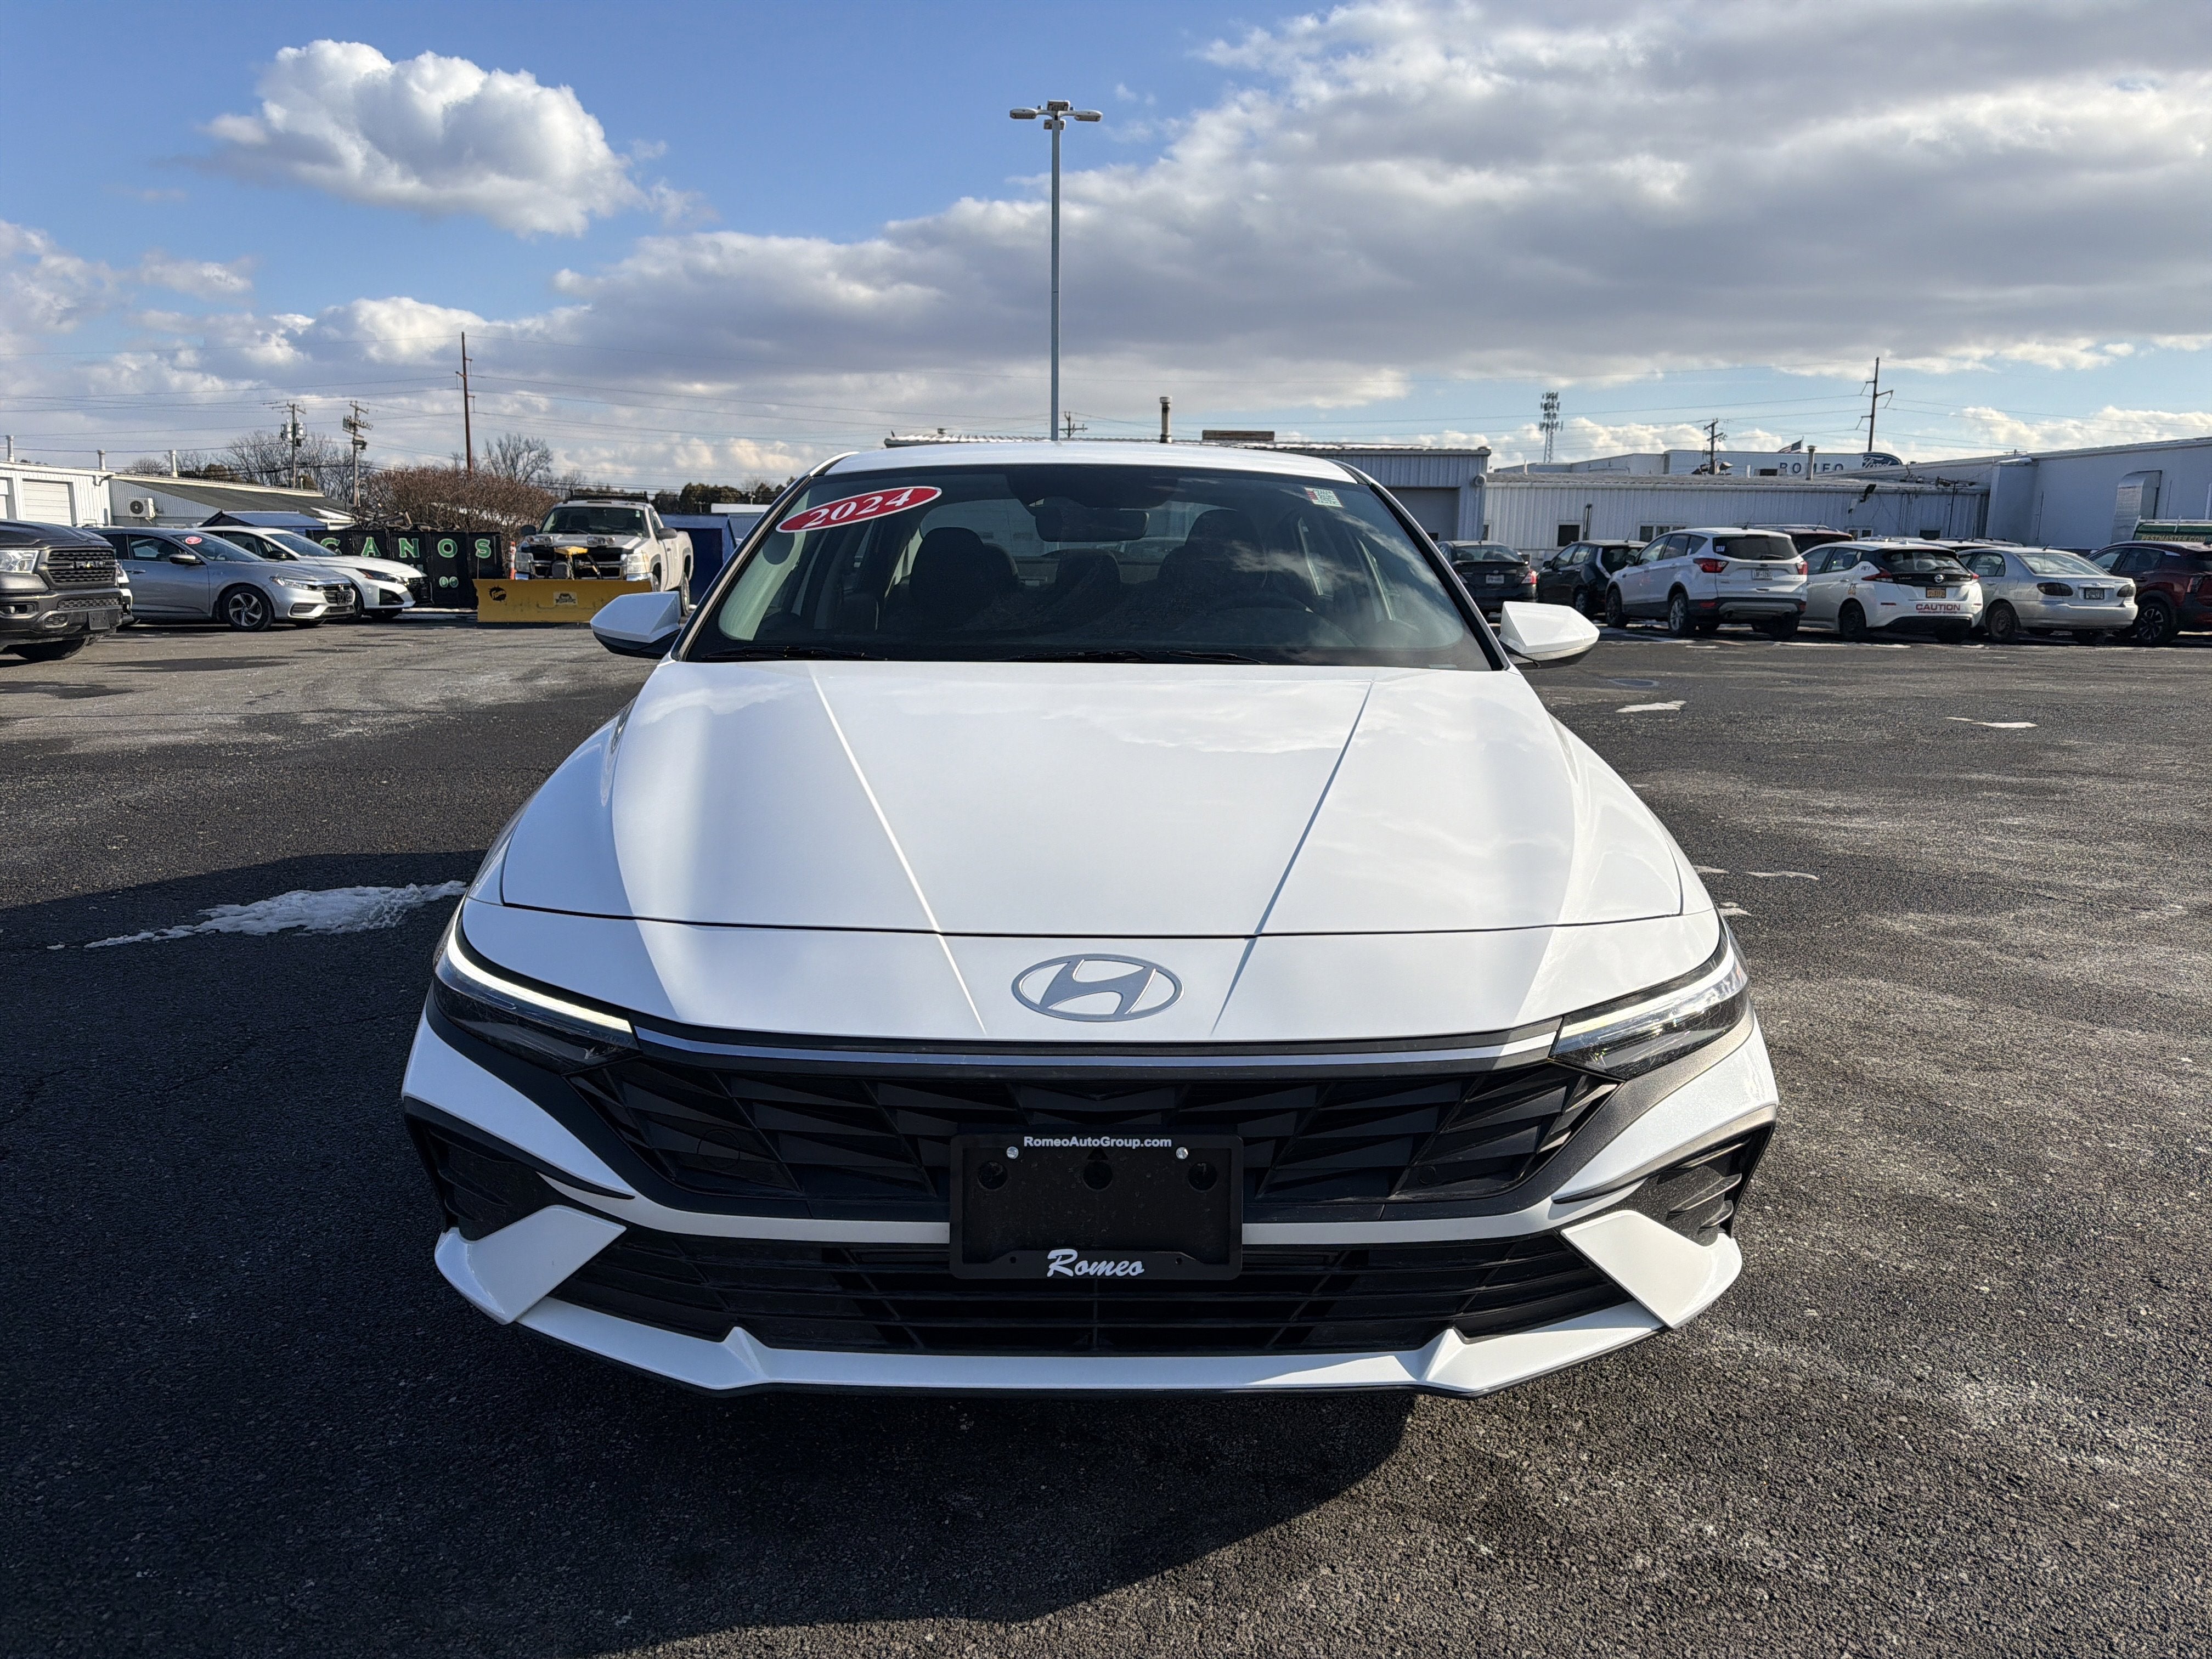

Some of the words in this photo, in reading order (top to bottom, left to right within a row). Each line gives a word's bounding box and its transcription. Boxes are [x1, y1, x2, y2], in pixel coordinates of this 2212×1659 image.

[1779, 462, 1843, 473] ROEO
[801, 489, 914, 529] 2024
[1024, 1136, 1172, 1149] RomeoAutoGroup.com
[1047, 1248, 1145, 1278] Romeo
